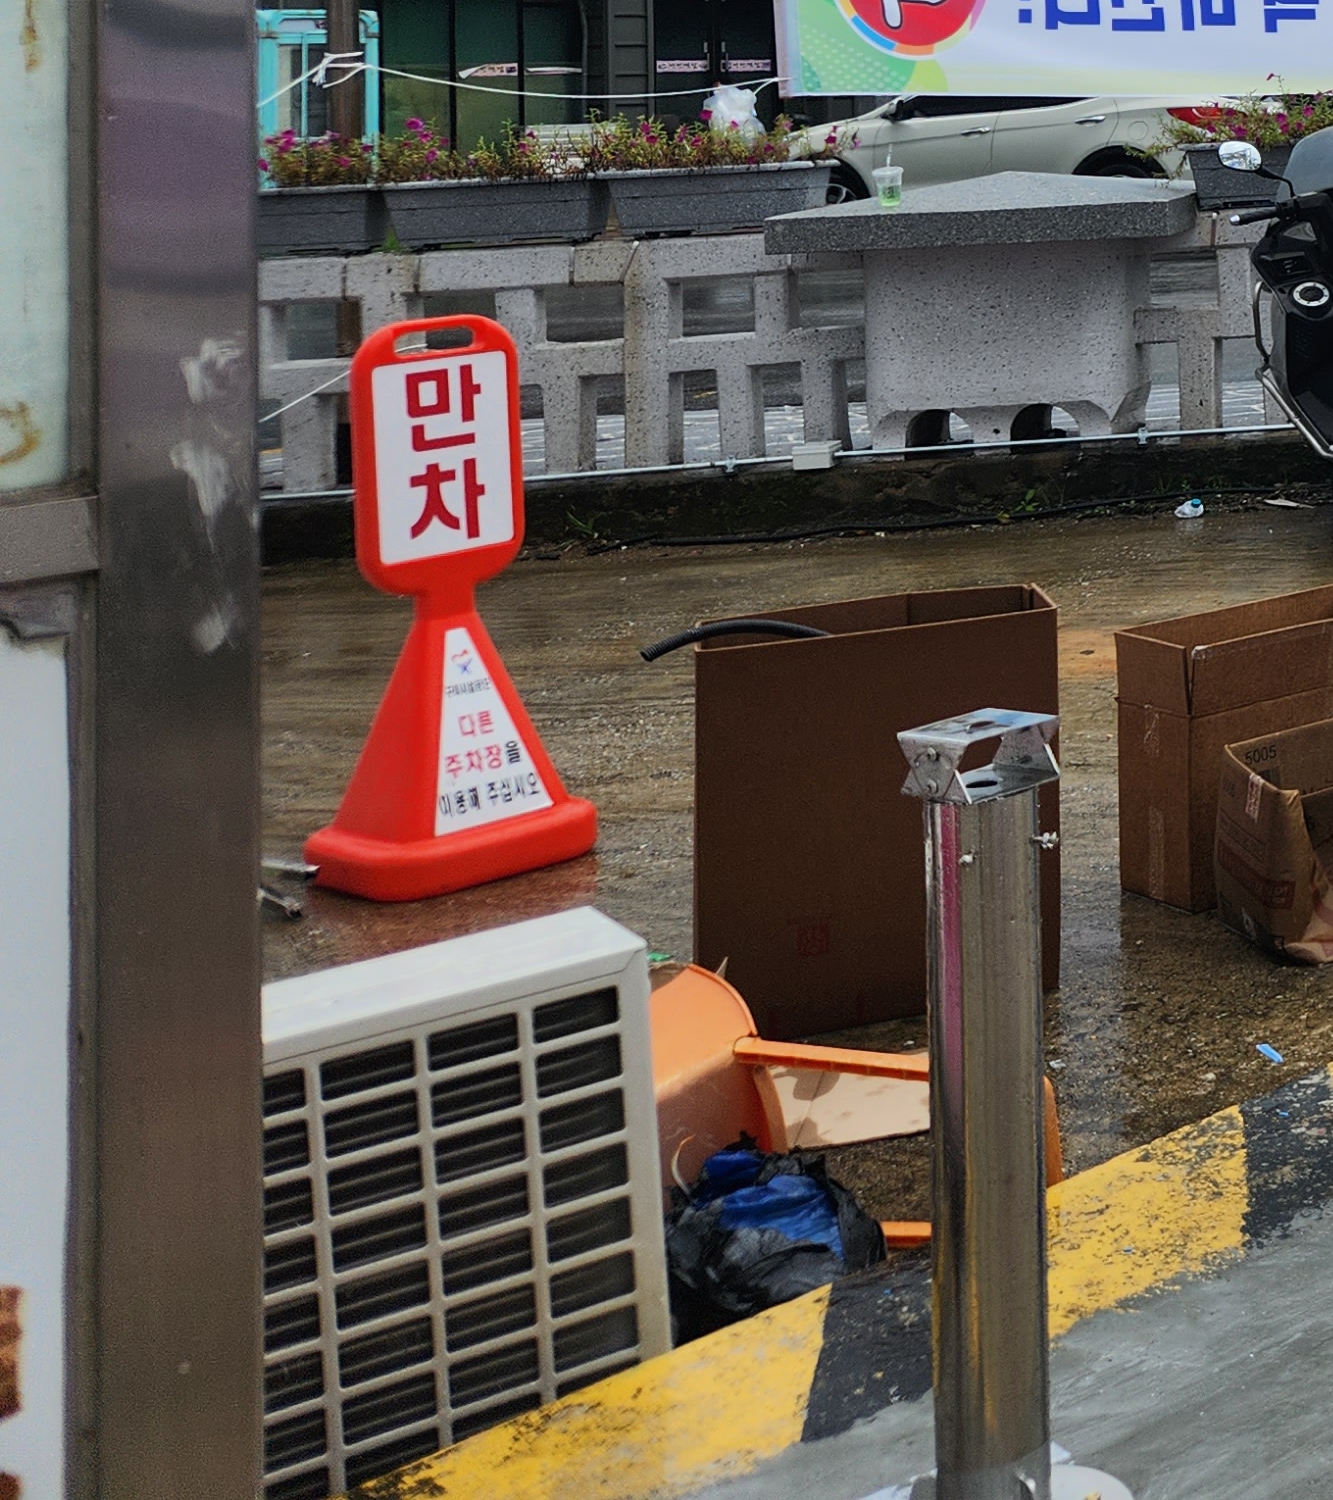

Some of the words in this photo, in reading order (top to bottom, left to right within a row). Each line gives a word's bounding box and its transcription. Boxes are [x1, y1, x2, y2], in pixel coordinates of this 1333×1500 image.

[404, 363, 486, 541] 만차
[458, 710, 494, 737] 다른
[445, 740, 521, 778] 주차장을
[1244, 745, 1277, 766] 5005
[486, 772, 541, 806] 주십시오
